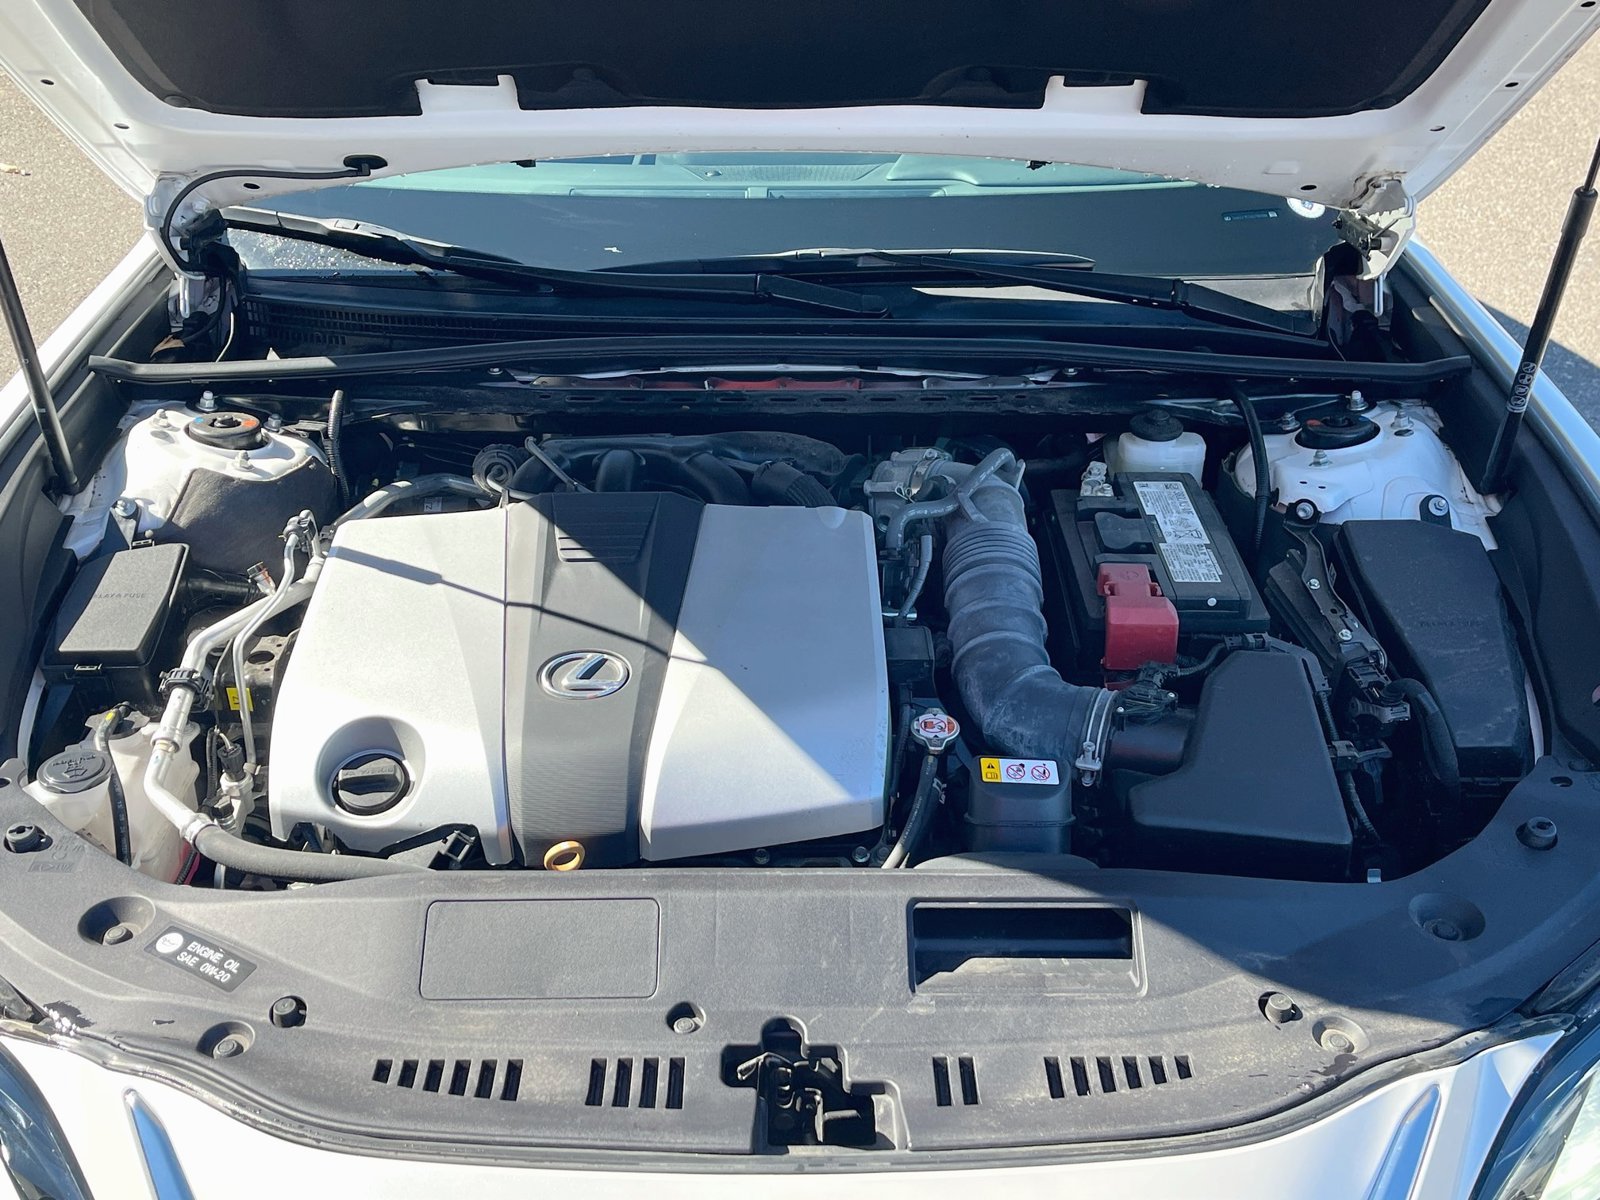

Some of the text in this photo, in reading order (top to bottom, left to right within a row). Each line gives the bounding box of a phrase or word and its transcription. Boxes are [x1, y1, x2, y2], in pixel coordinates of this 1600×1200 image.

[176, 951, 231, 983] SAE 0W-20
[187, 941, 240, 973] ENGINE OIL
